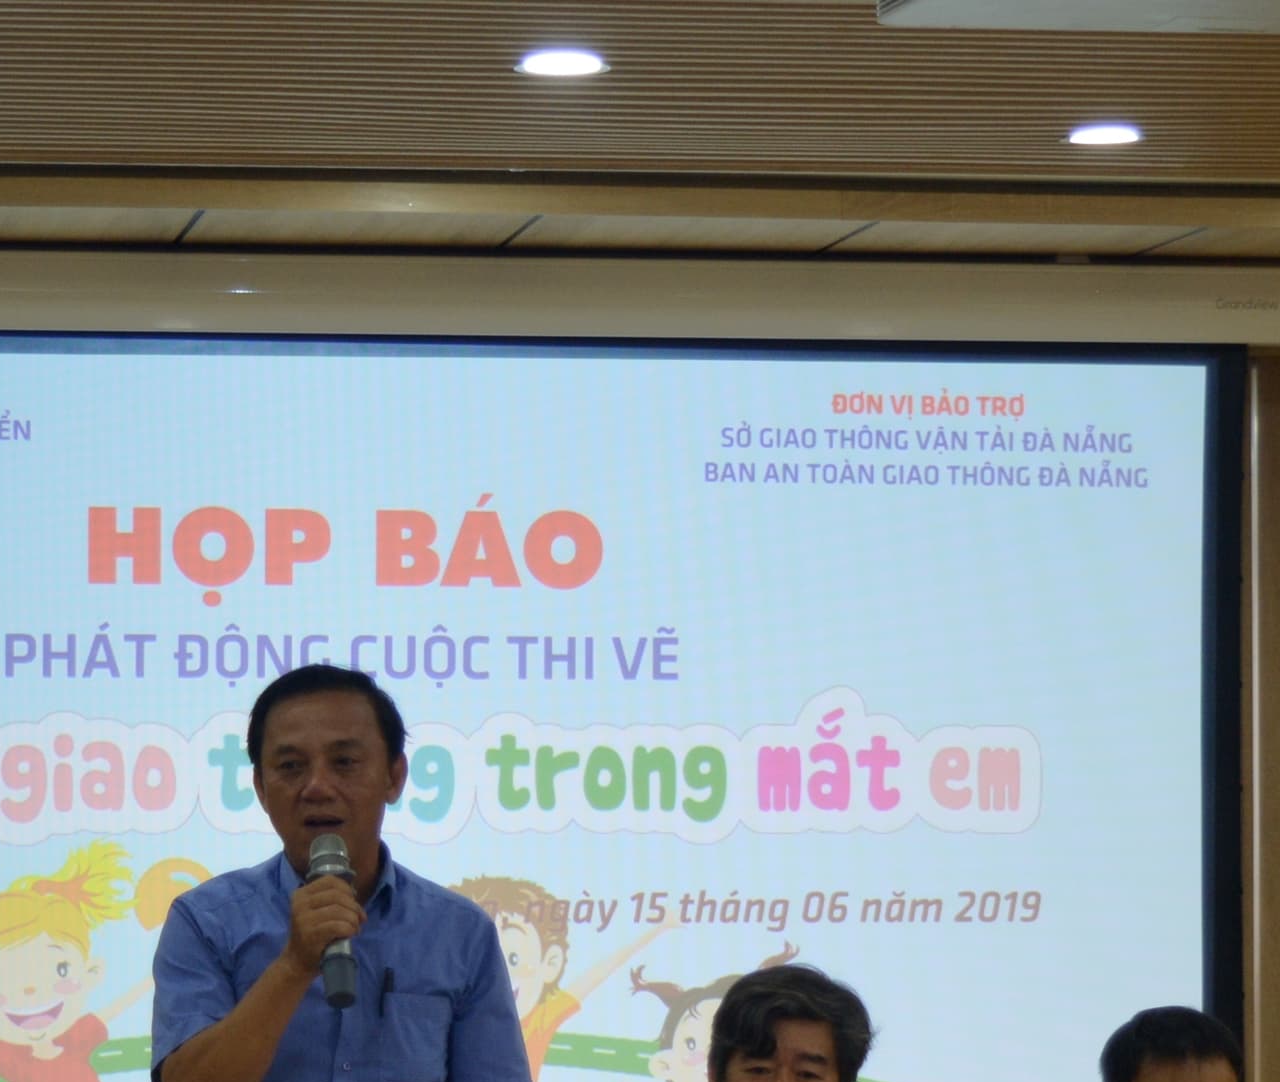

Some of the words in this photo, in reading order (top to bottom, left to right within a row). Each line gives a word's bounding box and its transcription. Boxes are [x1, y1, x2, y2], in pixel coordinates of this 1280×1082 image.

[832, 391, 884, 416] ĐƠN
[890, 394, 913, 421] VỊ
[921, 387, 970, 417] BẢO
[976, 393, 1025, 422] TRỢ
[721, 420, 752, 448] SỞ
[759, 427, 817, 449] GIAO
[824, 424, 909, 450] THÔNG
[916, 426, 968, 455] VẬN
[975, 424, 1014, 452] TẢI
[1022, 426, 1056, 453] ĐÀ
[1063, 424, 1133, 454] NẴNG
[704, 461, 756, 484] BAN
[763, 463, 799, 484] AN
[807, 459, 875, 485] TOÀN
[882, 464, 940, 486] GIAO
[946, 461, 1031, 487] THÔNG
[1038, 462, 1072, 488] ĐÀ
[1079, 459, 1149, 489] NẴNG
[87, 505, 332, 608] HỌP
[375, 493, 603, 590] BÁO
[4, 621, 156, 680] PHÁT
[174, 622, 332, 688] ĐỘNG
[349, 623, 490, 689] CUỘC
[506, 635, 595, 681] THI
[612, 626, 680, 681] VẼ
[0, 733, 177, 824] giao
[485, 733, 727, 823] trong
[757, 707, 901, 812] mắt
[929, 745, 1022, 811] em
[525, 890, 618, 933] ngày
[630, 891, 669, 924] 15
[679, 890, 789, 933] tháng
[802, 891, 849, 924] 06
[860, 890, 943, 924] năm
[954, 891, 1042, 924] 2019
